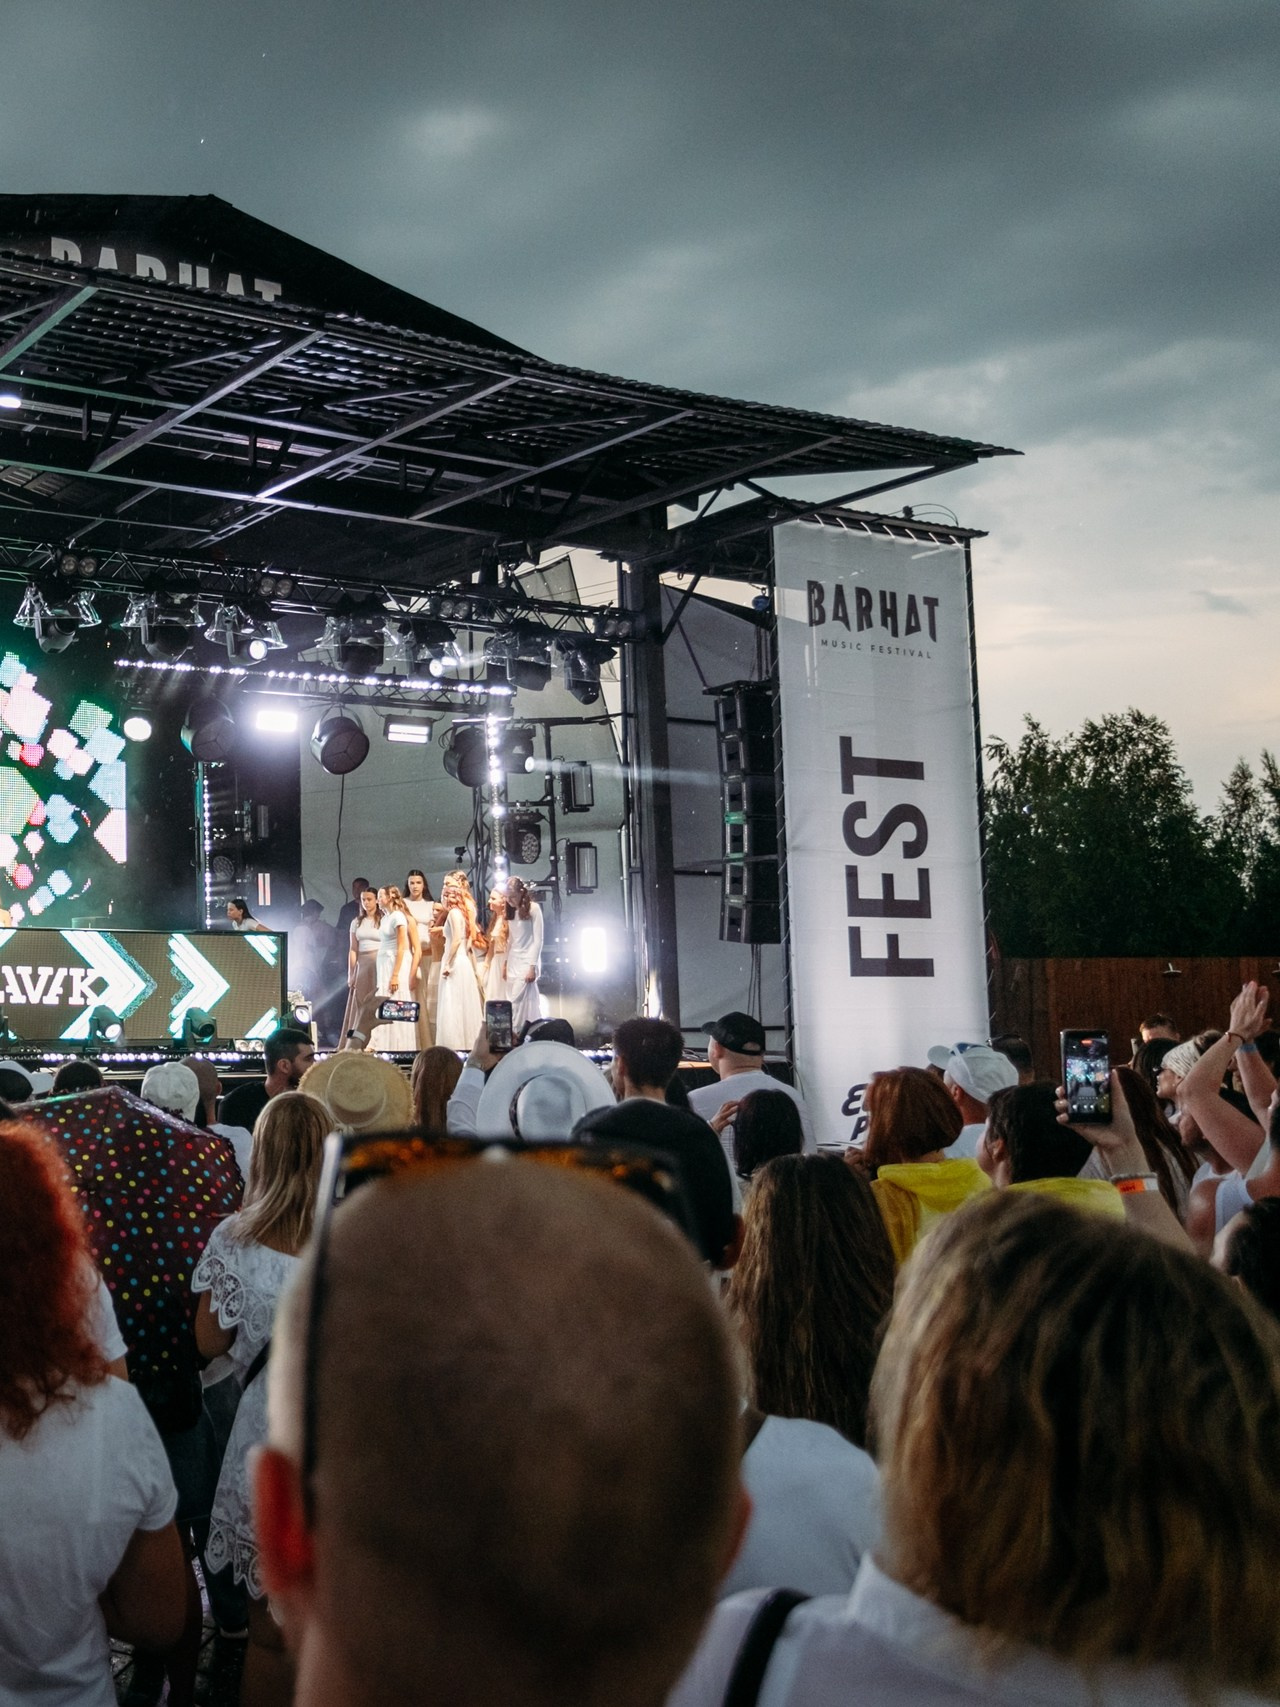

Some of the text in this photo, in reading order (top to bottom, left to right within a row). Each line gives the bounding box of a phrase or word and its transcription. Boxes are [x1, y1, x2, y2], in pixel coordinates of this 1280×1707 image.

[806, 579, 940, 643] BARHAT
[820, 639, 932, 659] MUSIC FESTIVAL
[838, 735, 936, 978] FEST
